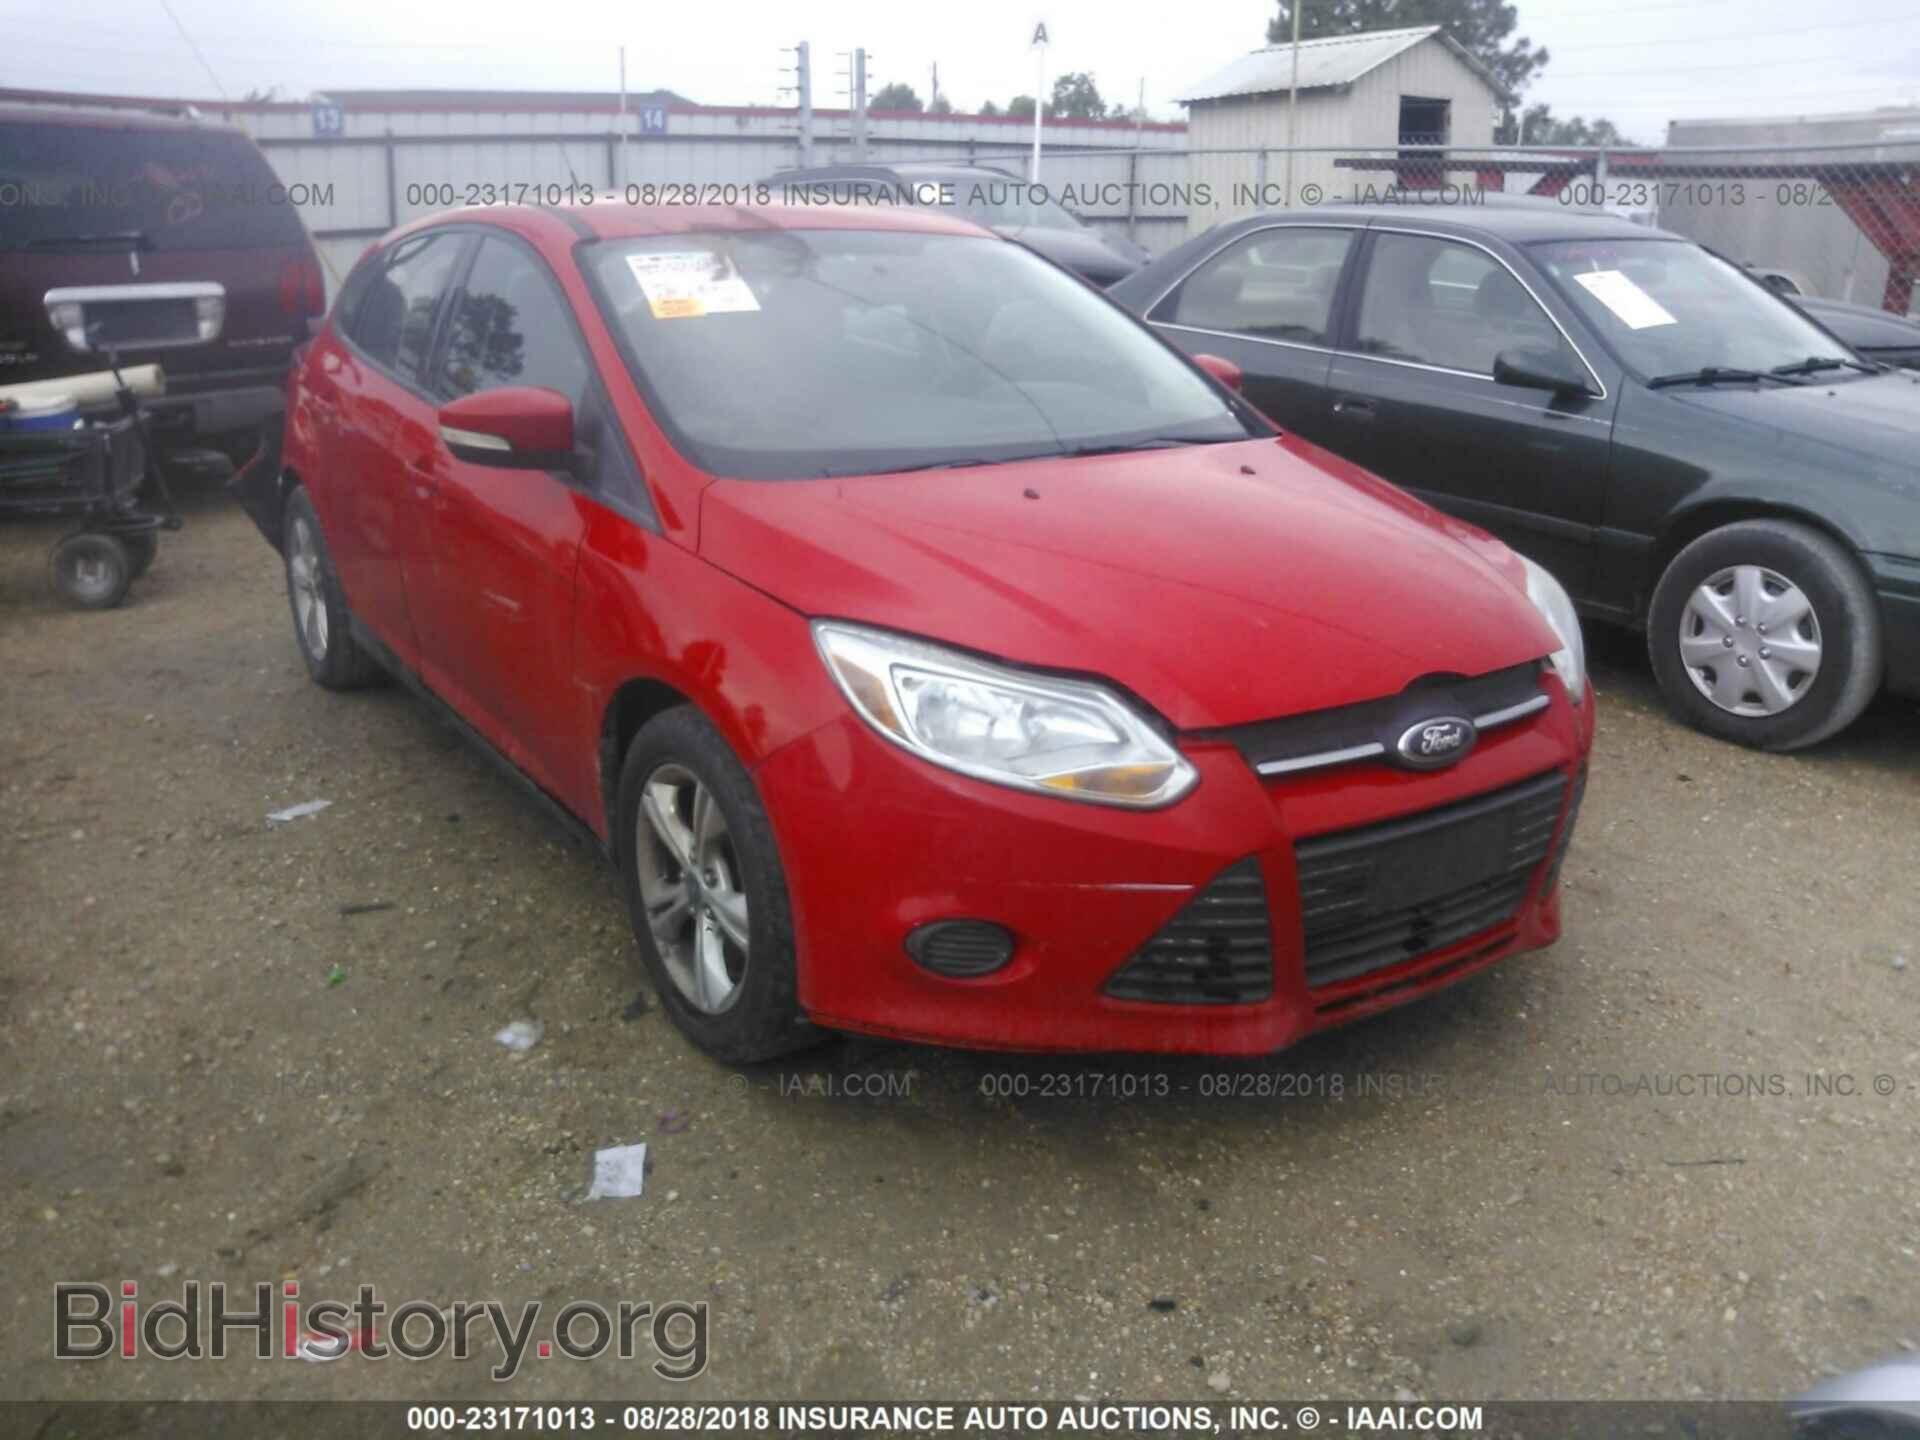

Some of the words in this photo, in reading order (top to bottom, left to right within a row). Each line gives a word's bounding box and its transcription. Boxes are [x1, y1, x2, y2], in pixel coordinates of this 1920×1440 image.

[1032, 22, 1048, 44] A
[317, 109, 339, 130] 13
[643, 109, 663, 129] 14
[1421, 724, 1461, 754] Ford
